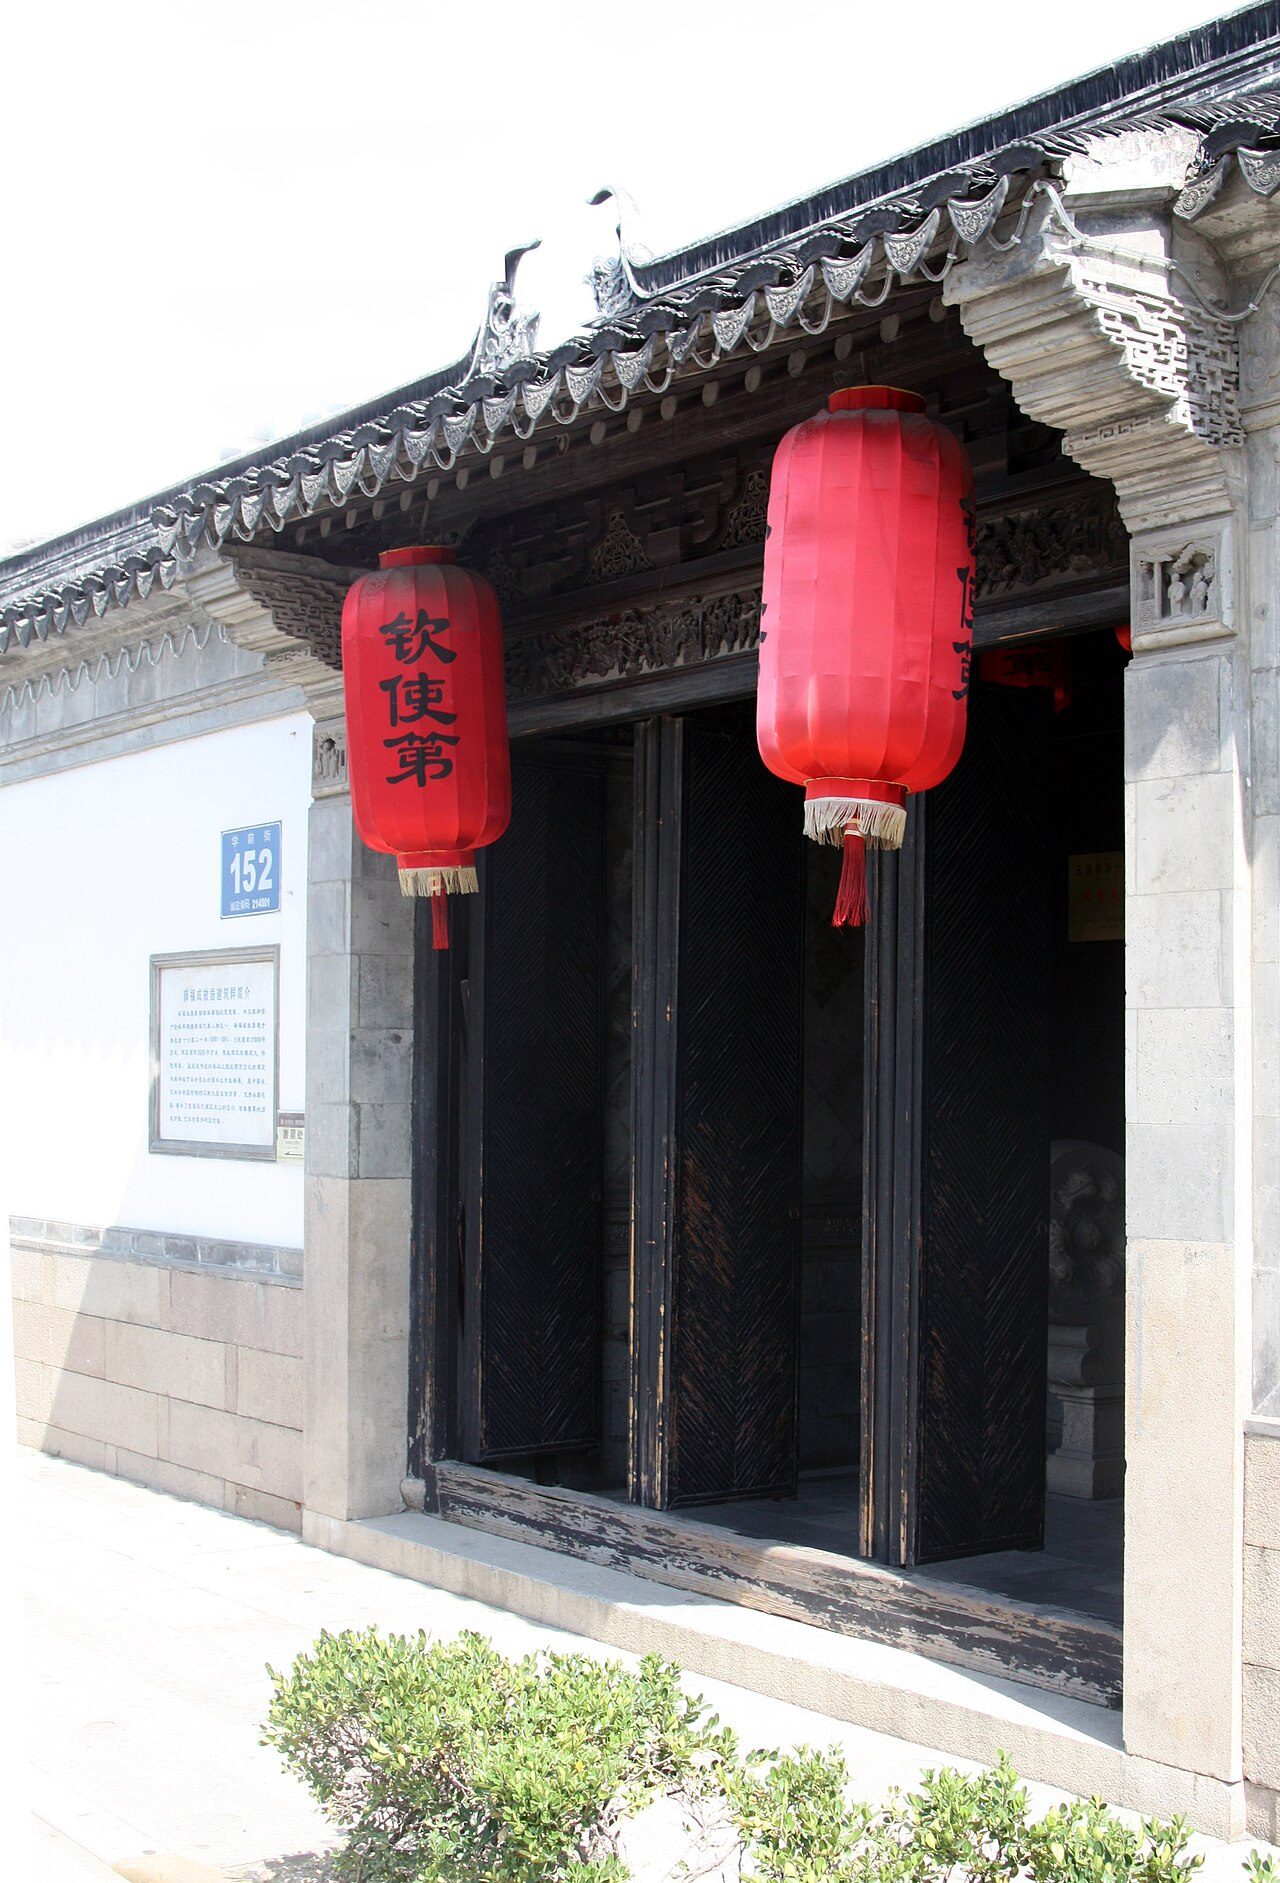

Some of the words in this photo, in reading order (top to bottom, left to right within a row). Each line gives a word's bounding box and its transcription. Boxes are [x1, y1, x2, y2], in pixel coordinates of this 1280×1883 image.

[378, 608, 461, 788] 钦使第
[230, 848, 273, 894] 152
